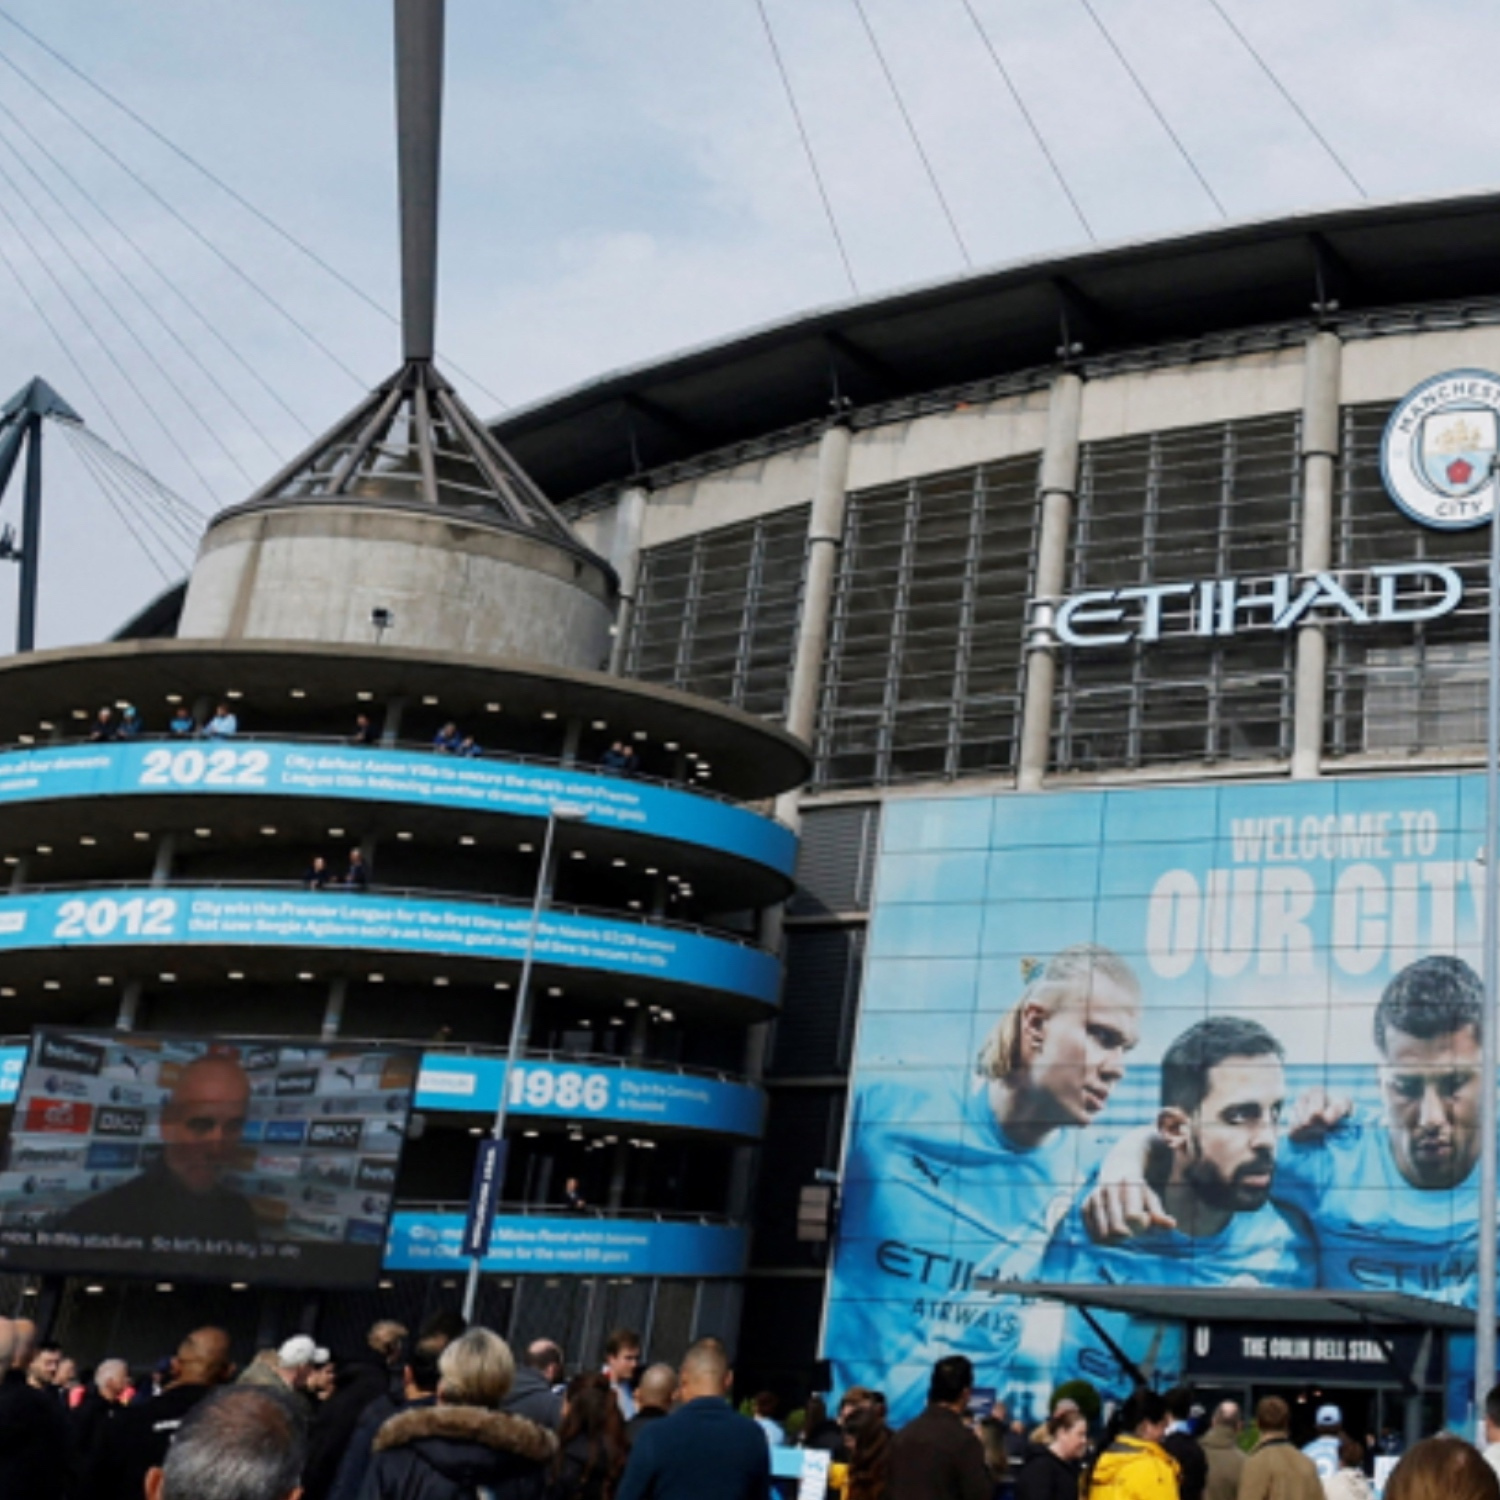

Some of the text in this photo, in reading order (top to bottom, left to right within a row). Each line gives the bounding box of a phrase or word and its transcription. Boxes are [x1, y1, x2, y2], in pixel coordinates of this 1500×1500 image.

[1434, 501, 1483, 516] CITY
[1055, 562, 1463, 647] ETIHAD
[138, 749, 270, 786] 2022
[282, 772, 334, 787] League
[285, 755, 315, 771] City
[318, 757, 363, 771] defeat
[410, 763, 439, 778] Villa
[1231, 810, 1440, 863] WELCOME TO
[53, 896, 178, 938] 2012
[191, 901, 222, 918] City
[224, 902, 251, 915] win
[253, 902, 277, 916] the
[279, 902, 337, 917] Premier
[340, 905, 393, 921] League
[396, 908, 417, 921] for
[1146, 867, 1317, 979] OUR
[509, 1068, 611, 1111] 1986
[911, 1297, 1020, 1338] AIRWAYS
[1195, 1326, 1210, 1357] U
[1242, 1337, 1268, 1358] THE
[1270, 1337, 1310, 1359] COLIN
[1313, 1338, 1346, 1361] BELL
